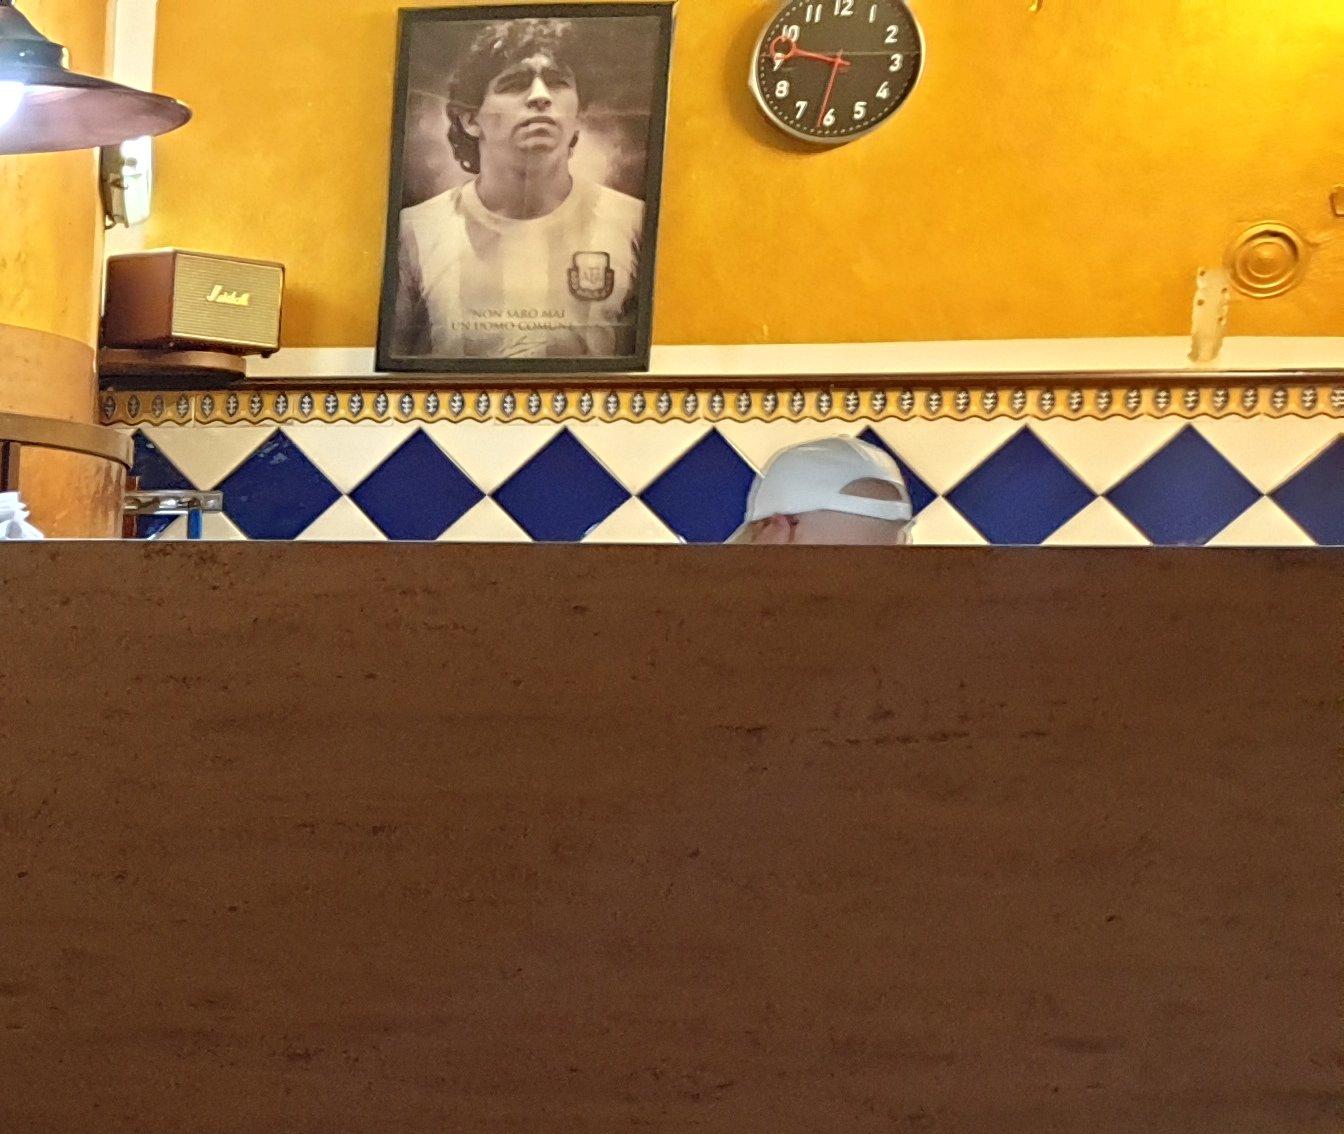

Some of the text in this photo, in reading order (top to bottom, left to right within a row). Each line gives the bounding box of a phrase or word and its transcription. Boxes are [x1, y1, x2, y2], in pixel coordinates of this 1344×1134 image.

[805, 4, 823, 23] 11
[834, 0, 854, 16] 12
[868, 4, 878, 23] 1
[782, 24, 800, 43] 10
[884, 24, 899, 44] 2
[889, 53, 904, 73] 3
[775, 80, 790, 99] 8
[875, 80, 891, 99] 4
[795, 100, 808, 119] 7
[822, 107, 836, 127] 6
[853, 101, 868, 120] 5
